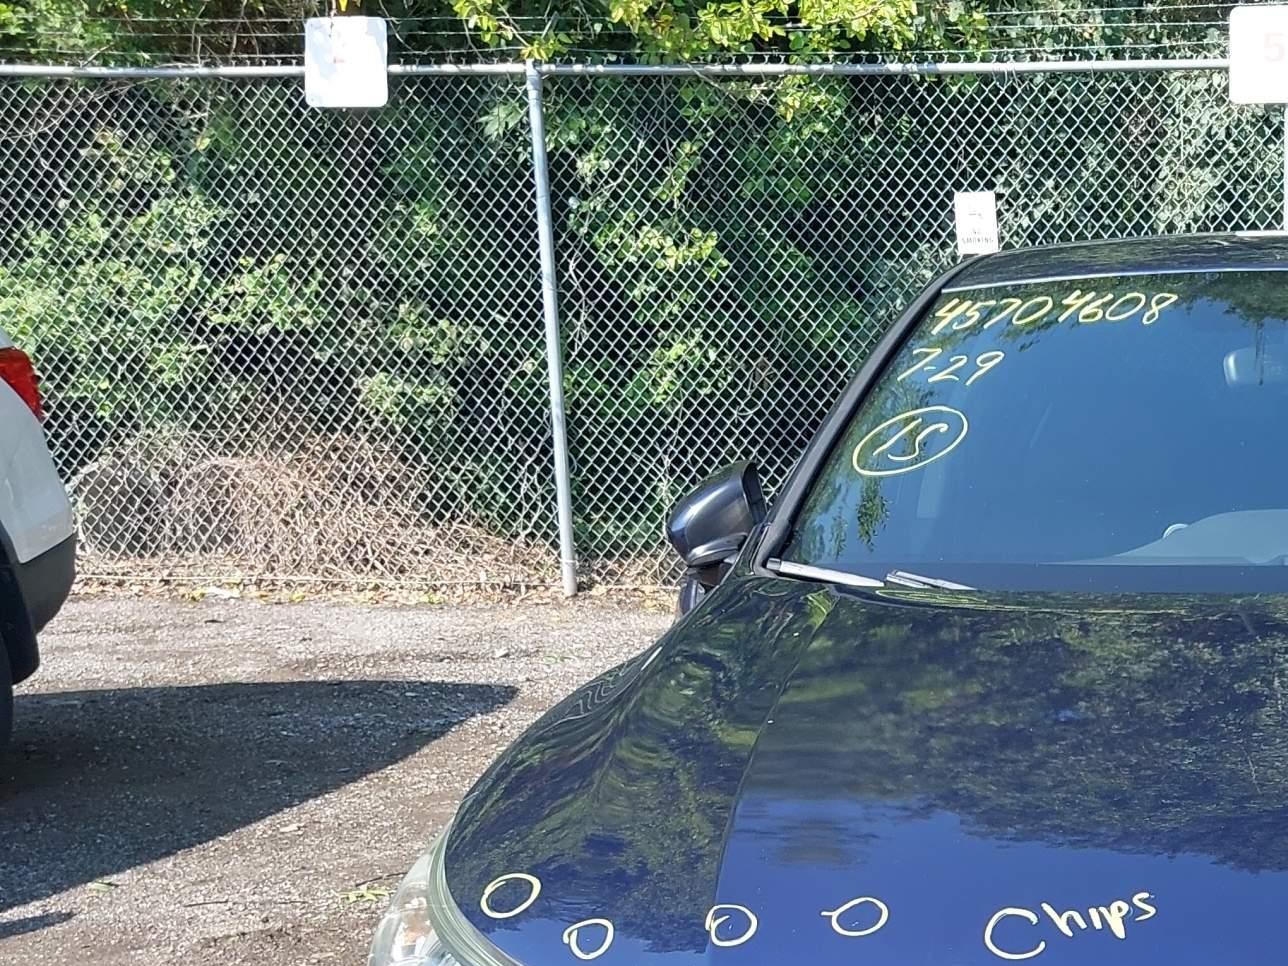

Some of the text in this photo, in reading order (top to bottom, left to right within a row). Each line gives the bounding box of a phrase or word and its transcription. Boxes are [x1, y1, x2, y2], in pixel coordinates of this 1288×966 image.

[1264, 32, 1287, 61] 5
[930, 289, 1179, 336] 45704608
[896, 347, 1006, 386] 7-29
[983, 891, 1158, 961] Chips
